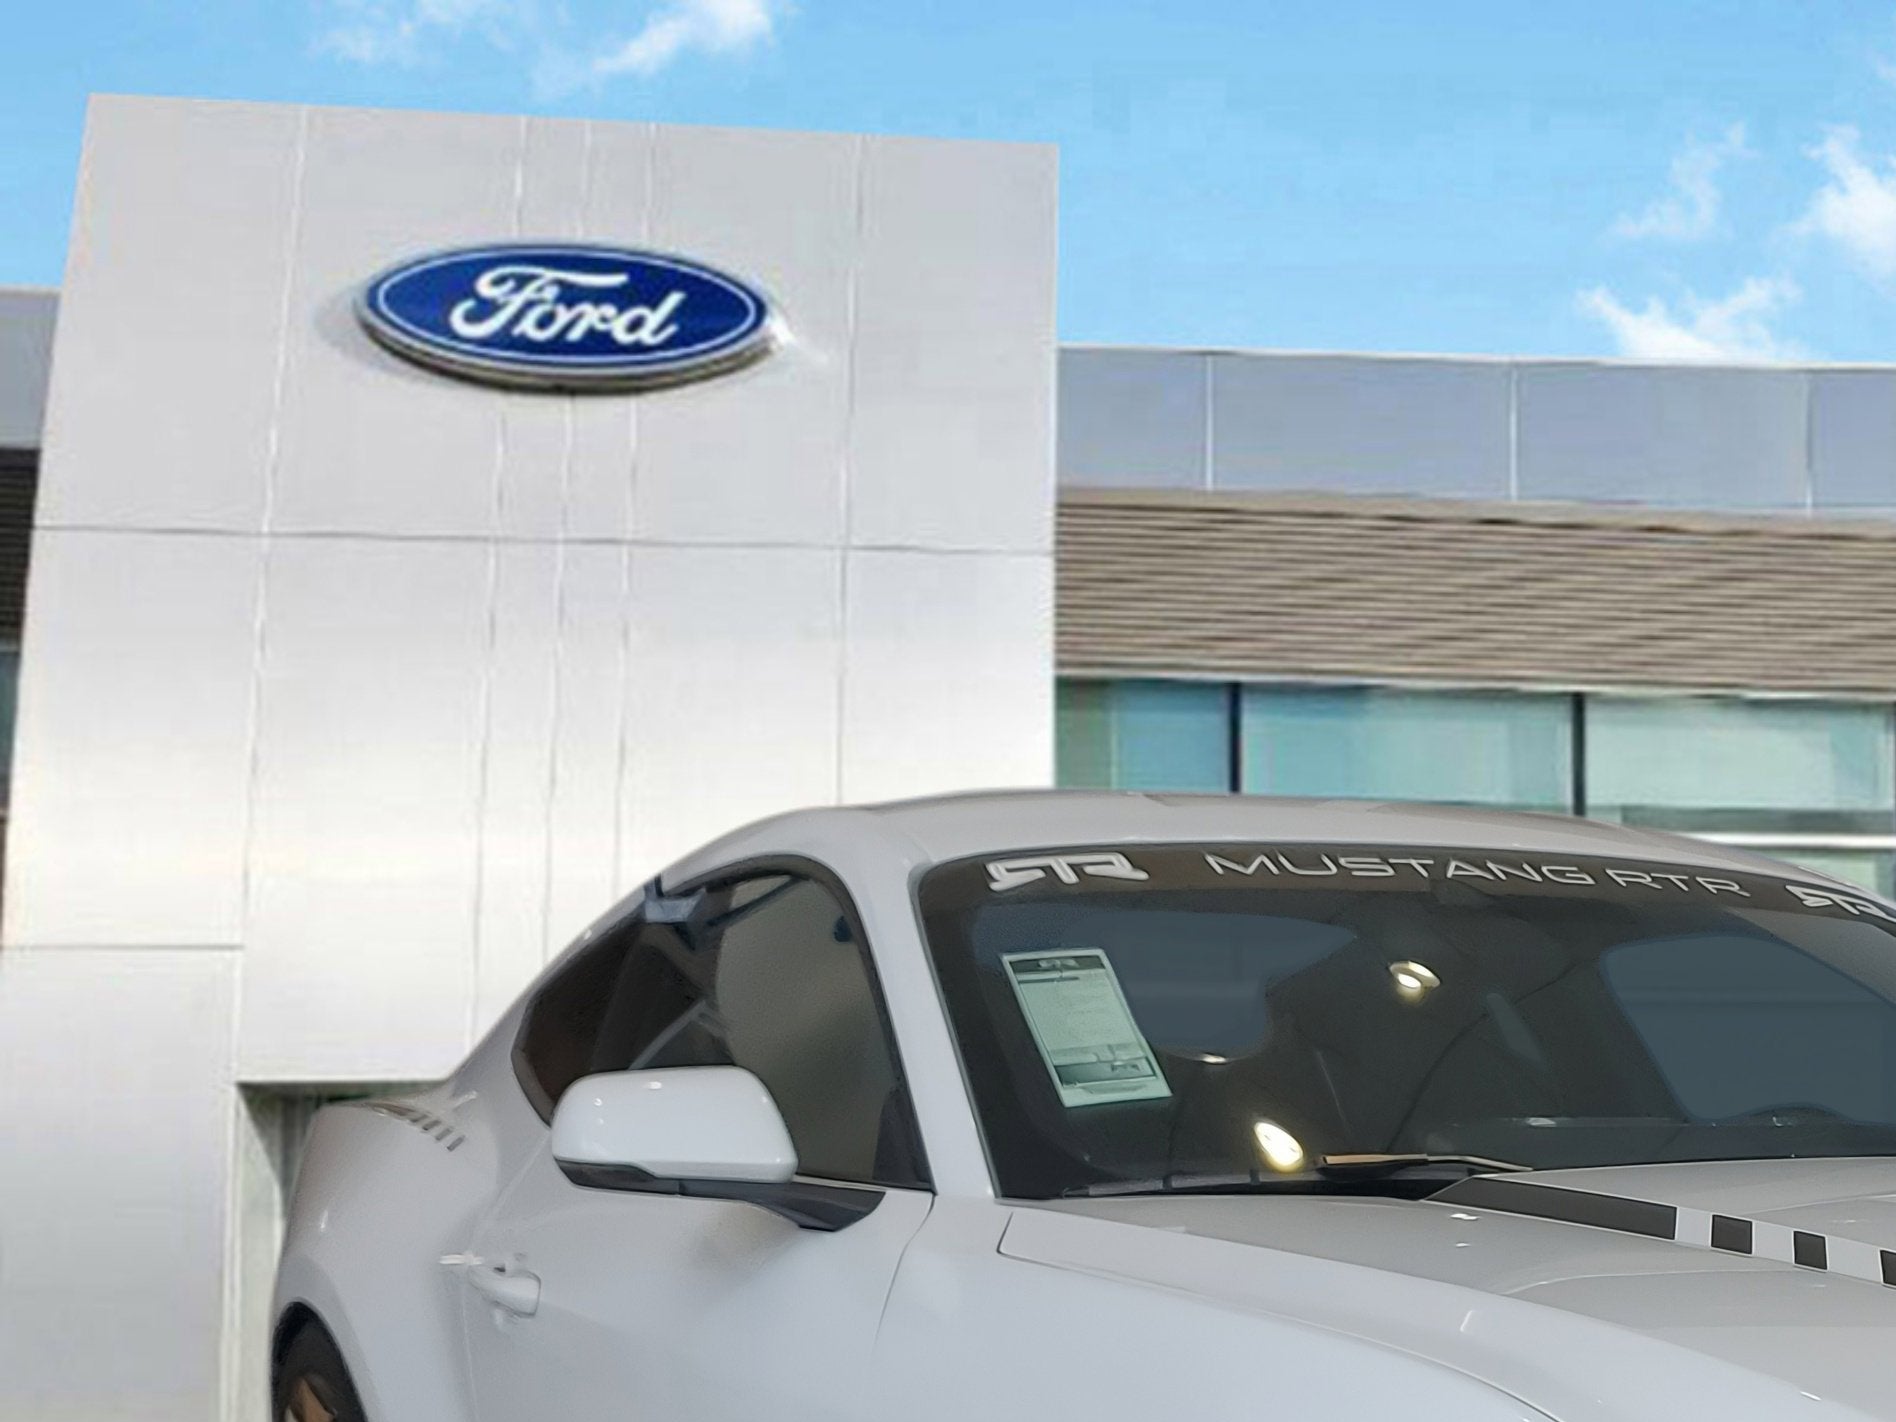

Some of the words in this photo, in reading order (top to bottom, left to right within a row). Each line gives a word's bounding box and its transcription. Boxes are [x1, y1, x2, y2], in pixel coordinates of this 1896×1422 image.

[449, 264, 686, 347] Ford
[1202, 850, 1596, 886] MUSTANG
[1605, 867, 1751, 897] RTR
